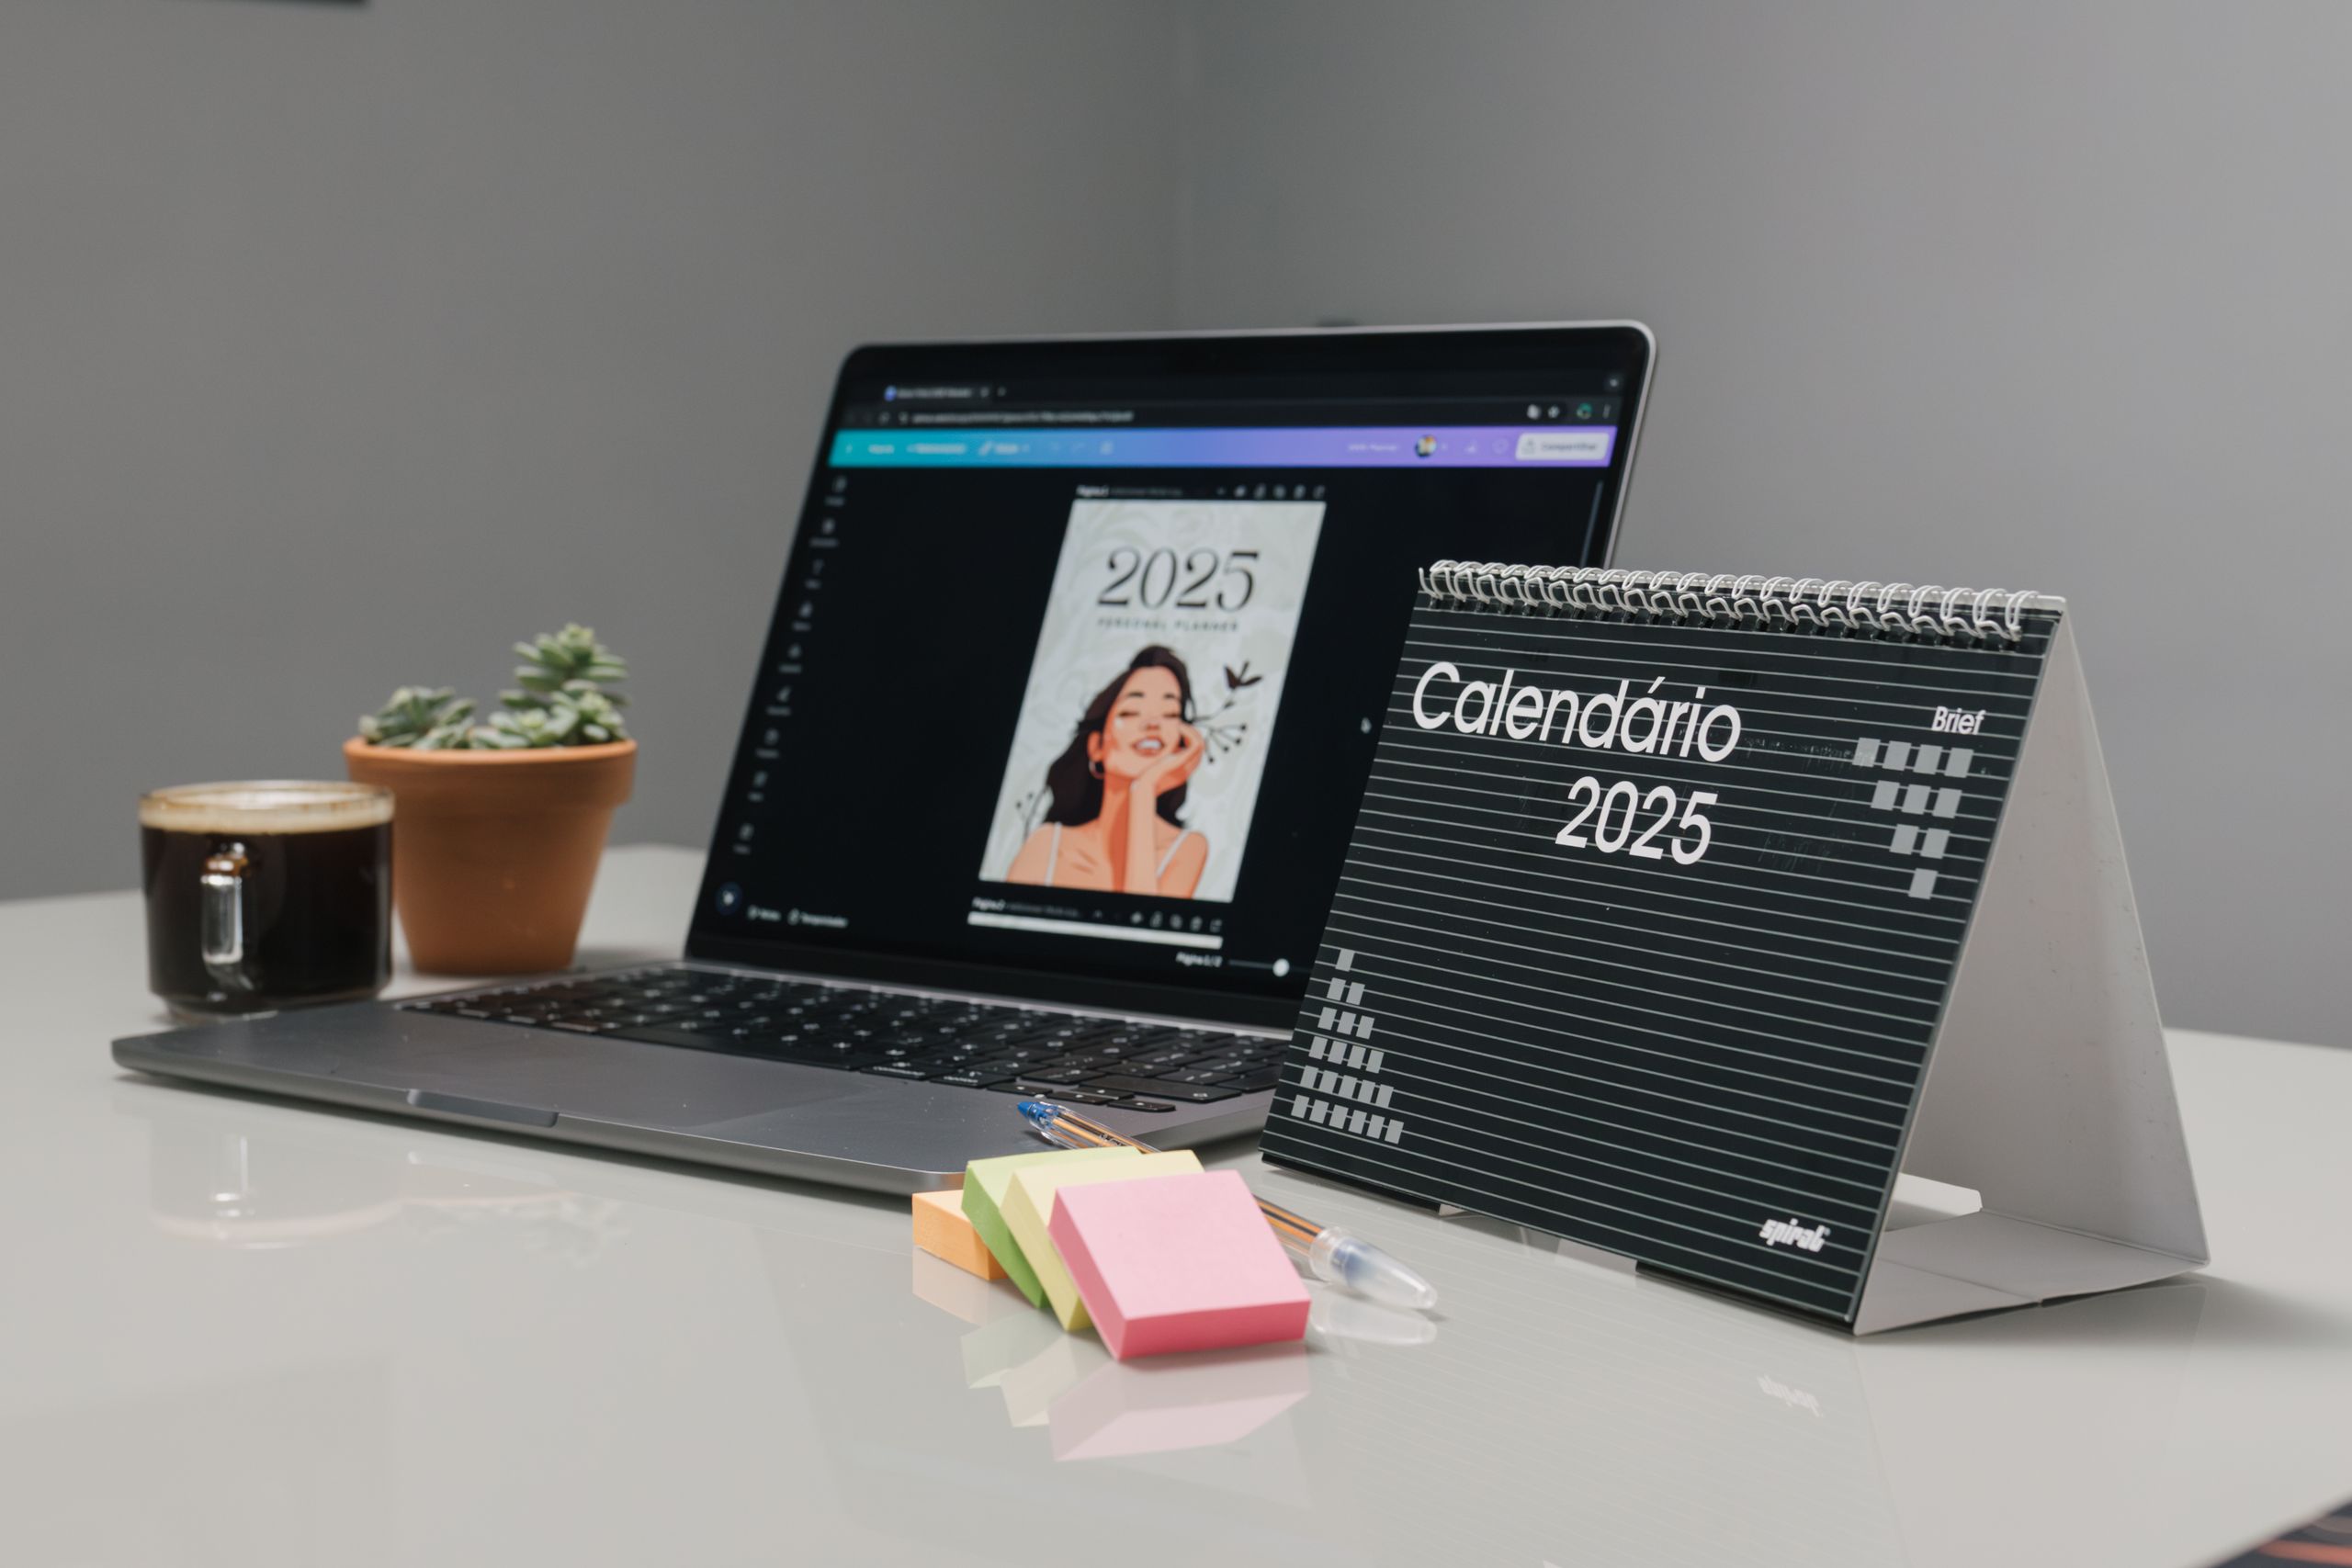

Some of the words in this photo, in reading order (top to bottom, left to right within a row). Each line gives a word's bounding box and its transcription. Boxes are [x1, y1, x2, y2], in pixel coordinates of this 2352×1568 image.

[1097, 547, 1260, 613] 2025
[1412, 660, 1742, 762] Calendário
[1931, 705, 1986, 735] Brief
[1555, 775, 1719, 865] 2025
[1758, 1218, 1826, 1253] spiral
